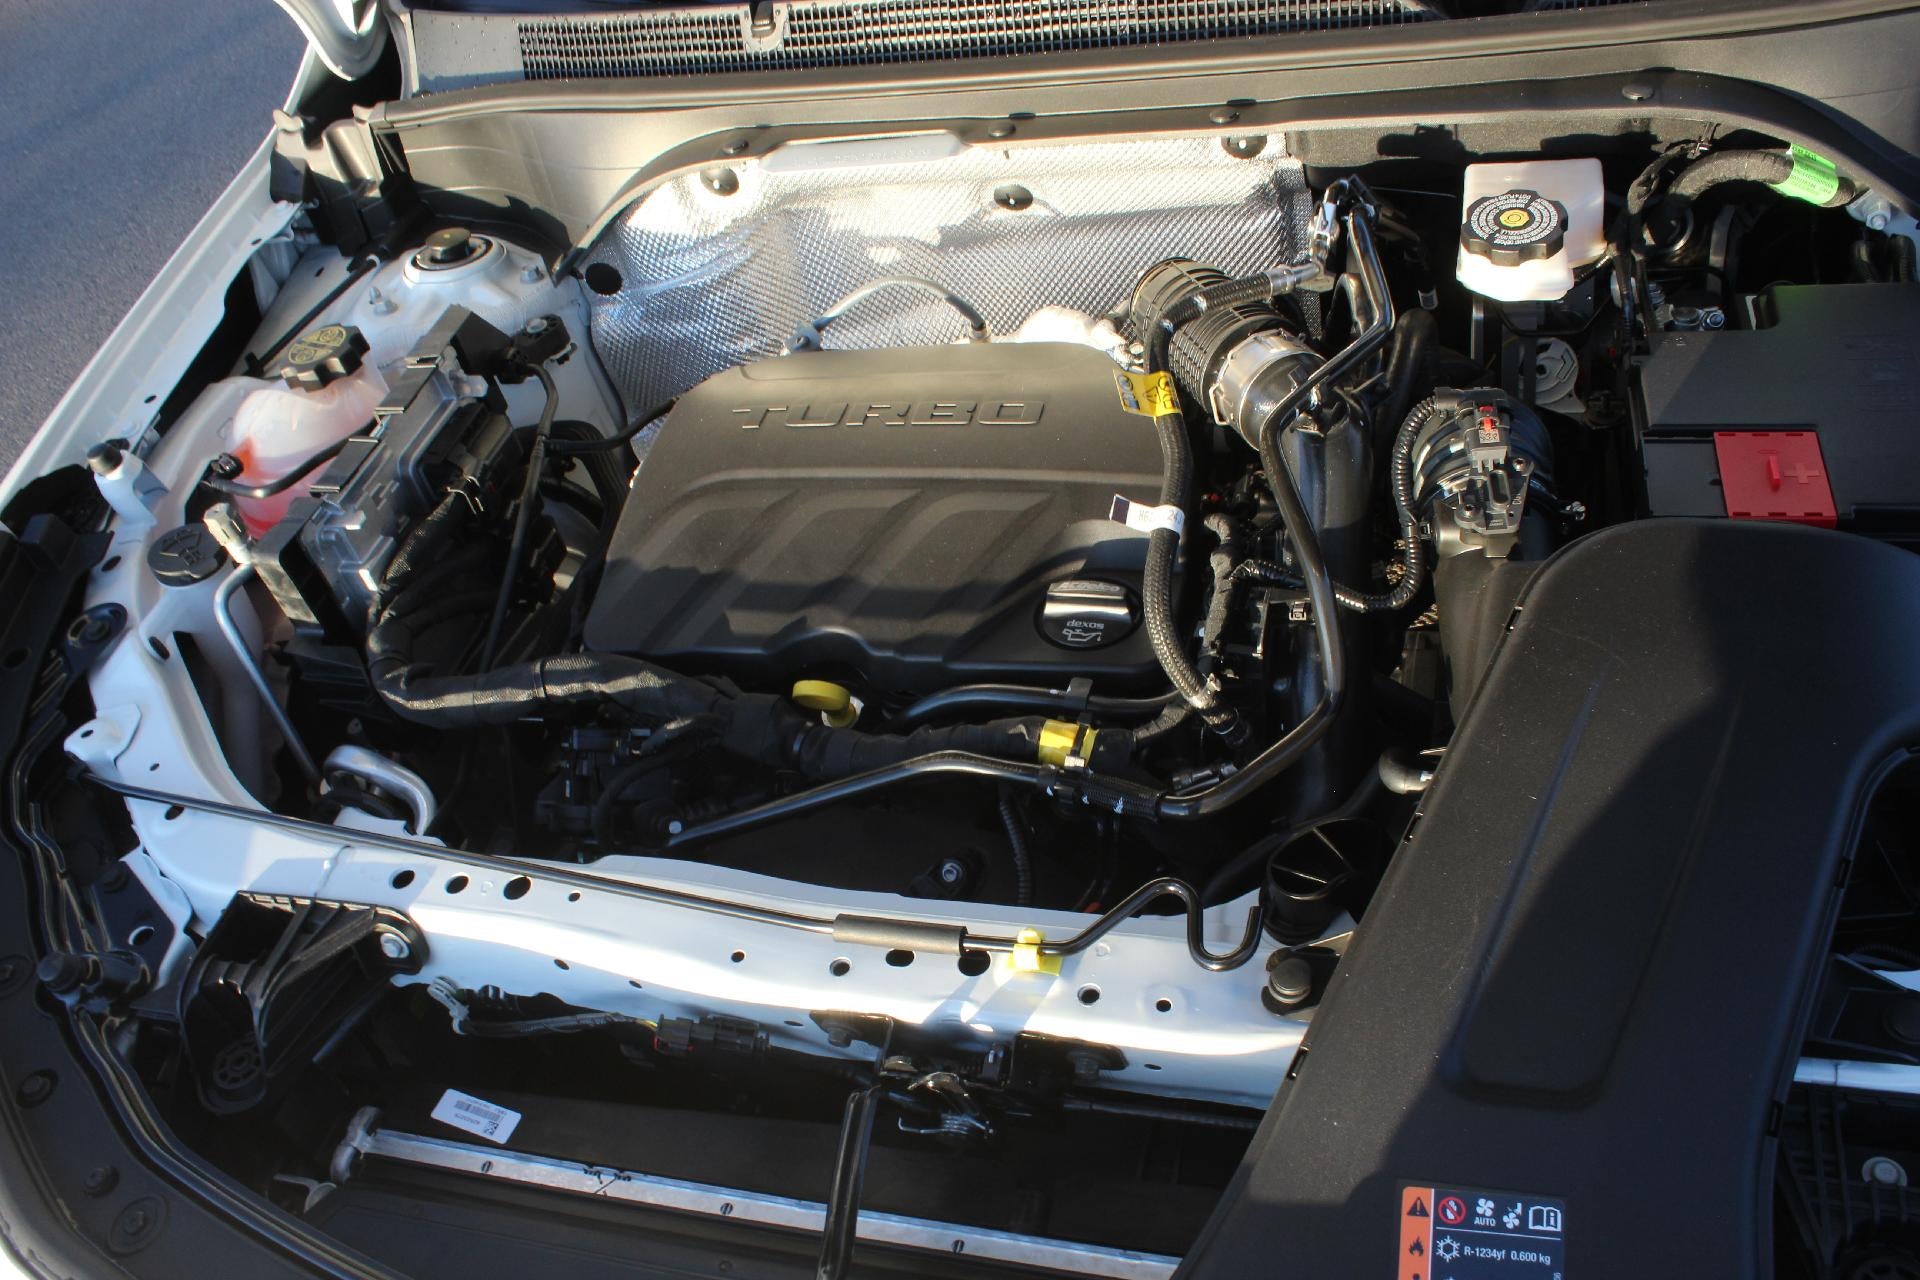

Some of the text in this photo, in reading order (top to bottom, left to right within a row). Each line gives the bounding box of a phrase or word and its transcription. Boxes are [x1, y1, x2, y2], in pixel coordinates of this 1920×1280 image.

[732, 402, 1045, 430] TURBO
[1066, 619, 1105, 630] dexos
[1474, 1216, 1496, 1227] AUTO
[1464, 1245, 1551, 1266] R-1234yf 0.600 kg
